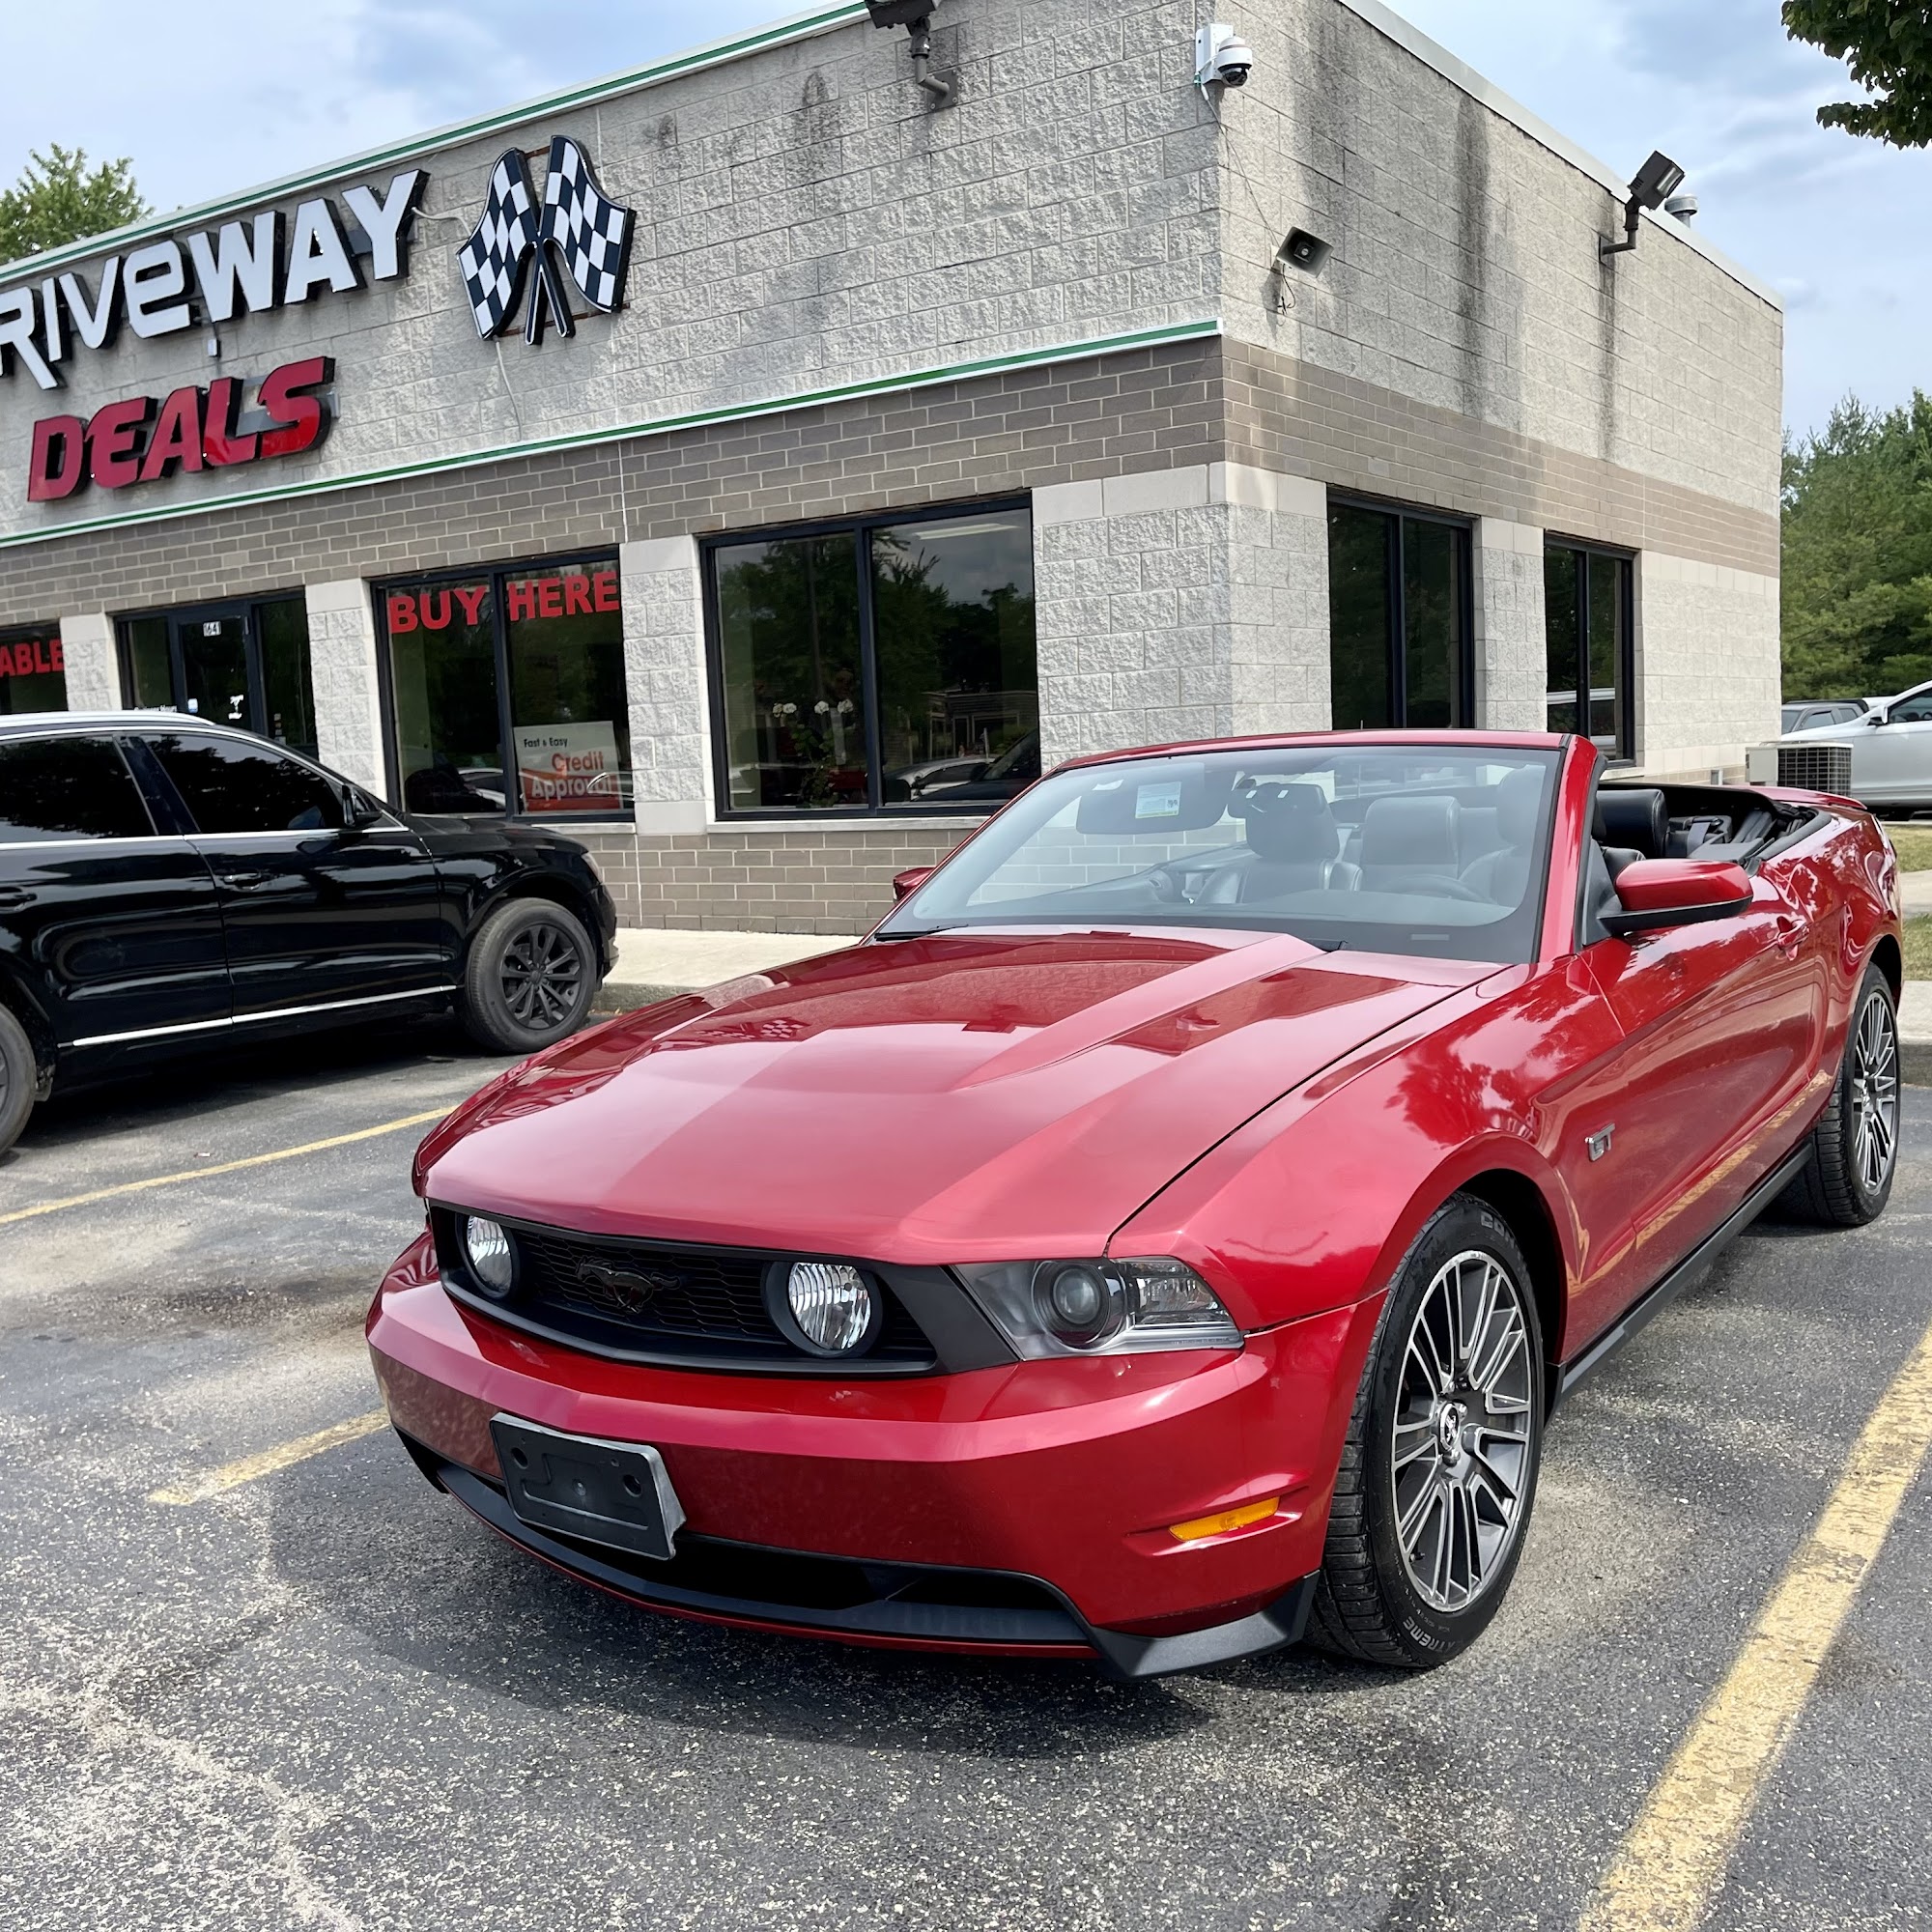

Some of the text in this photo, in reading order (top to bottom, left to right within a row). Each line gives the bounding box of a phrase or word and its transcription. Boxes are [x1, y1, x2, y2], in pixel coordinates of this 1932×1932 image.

[27, 355, 333, 502] DEALS
[388, 571, 620, 634] BUY HERE
[0, 639, 64, 677] ABLE
[524, 738, 540, 748] Fast
[549, 737, 568, 748] Easy
[552, 751, 605, 772] Credit
[1585, 1122, 1616, 1162] GT
